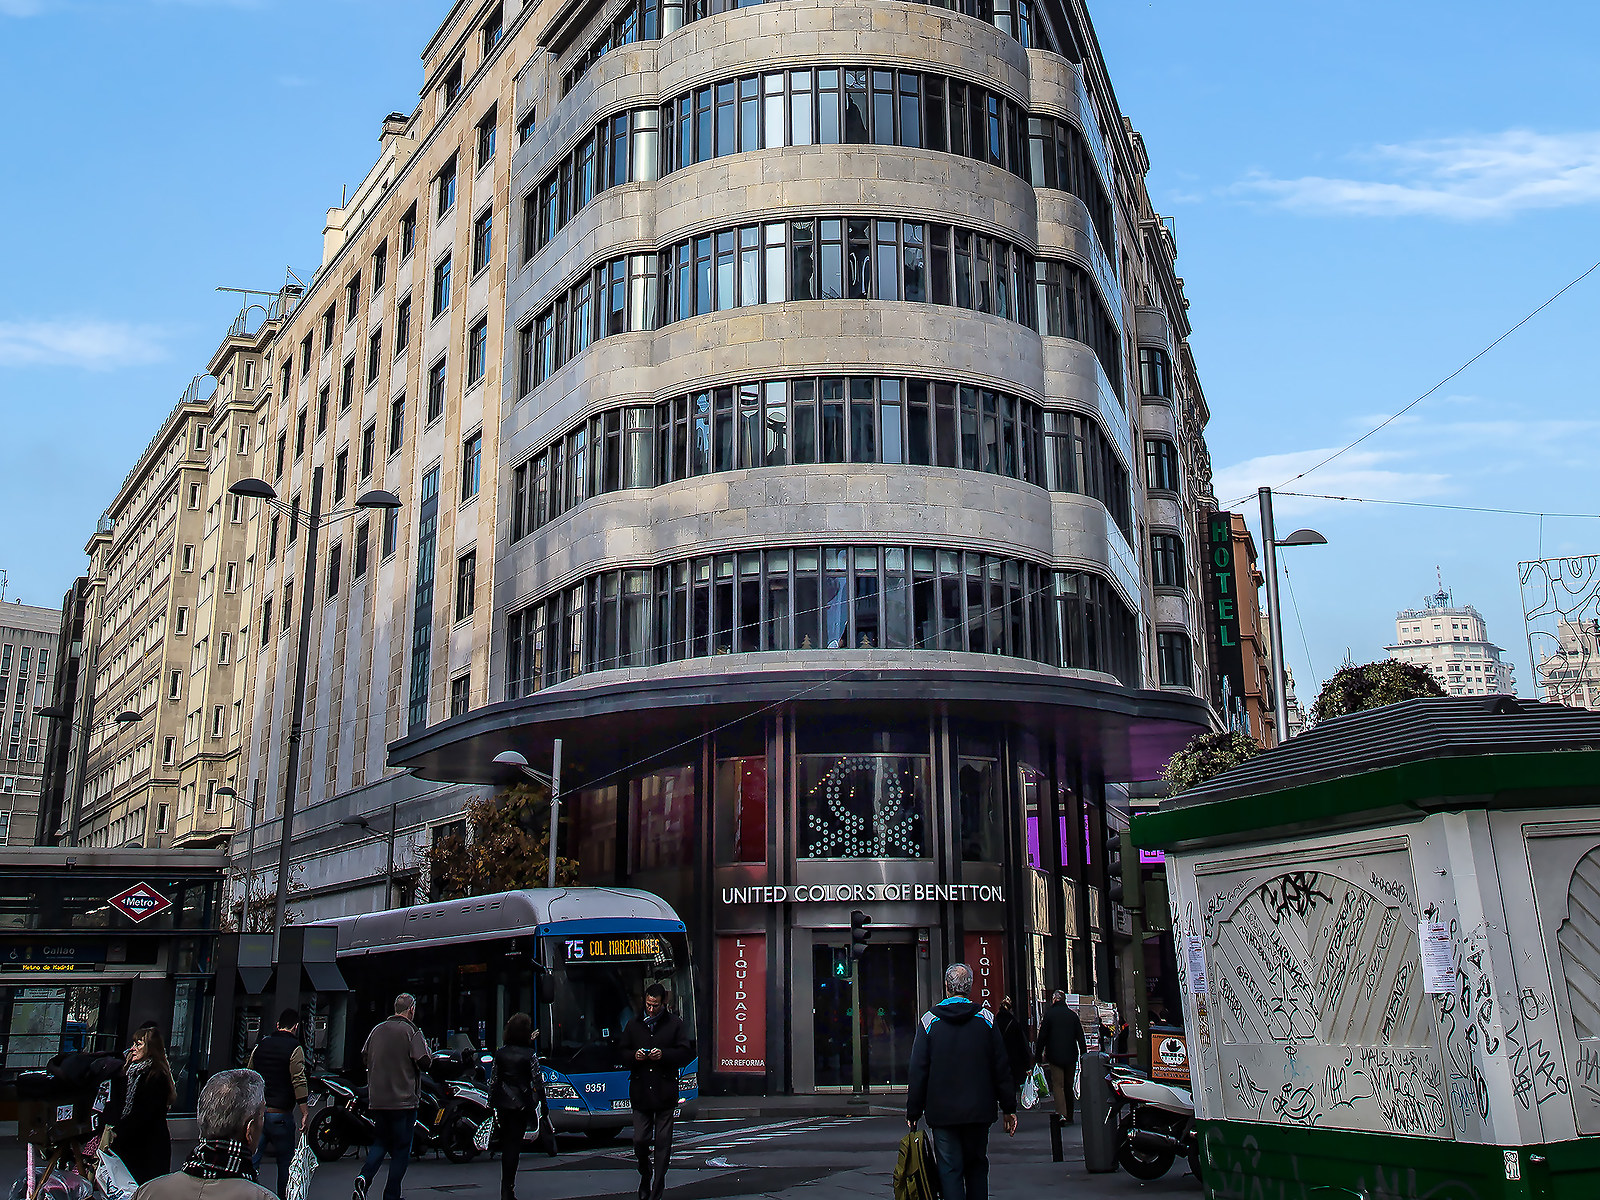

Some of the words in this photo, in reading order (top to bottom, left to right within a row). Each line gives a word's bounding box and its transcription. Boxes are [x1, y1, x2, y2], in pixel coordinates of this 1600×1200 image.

[1212, 521, 1236, 647] HOTEL
[722, 886, 787, 904] UNITED
[794, 884, 875, 902] COLORS
[882, 884, 910, 901] OF
[126, 897, 153, 907] Metro
[43, 946, 75, 955] Callao
[565, 940, 584, 959] 75
[589, 941, 607, 956] COL.
[609, 939, 660, 955] MANZANARES
[735, 939, 748, 1054] LIQUIDACIÓN
[734, 1059, 765, 1067] REFORMA
[585, 1083, 606, 1093] 9351
